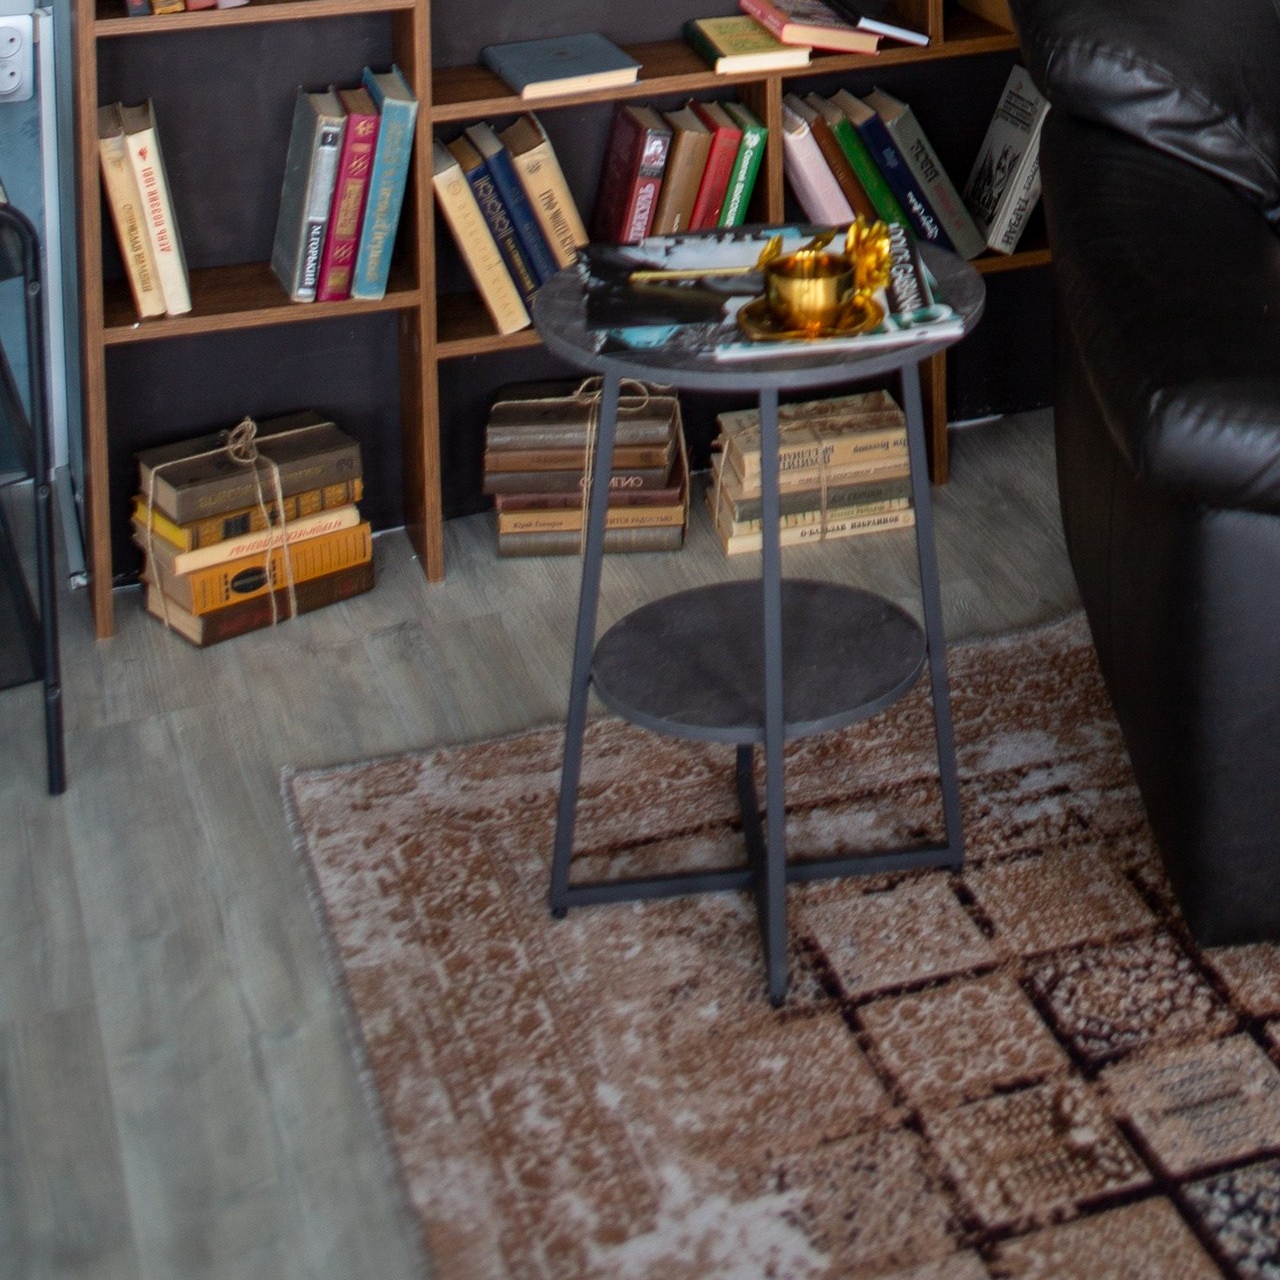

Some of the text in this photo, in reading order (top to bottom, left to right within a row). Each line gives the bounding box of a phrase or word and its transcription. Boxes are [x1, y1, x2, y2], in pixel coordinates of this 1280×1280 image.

[146, 188, 172, 253] ДЕНЬ ПОЭЗИИ
[1001, 198, 1029, 247] ТАРЗАН
[300, 224, 324, 286] М.ГОРЬКИЙ
[513, 522, 533, 530] Юрий
